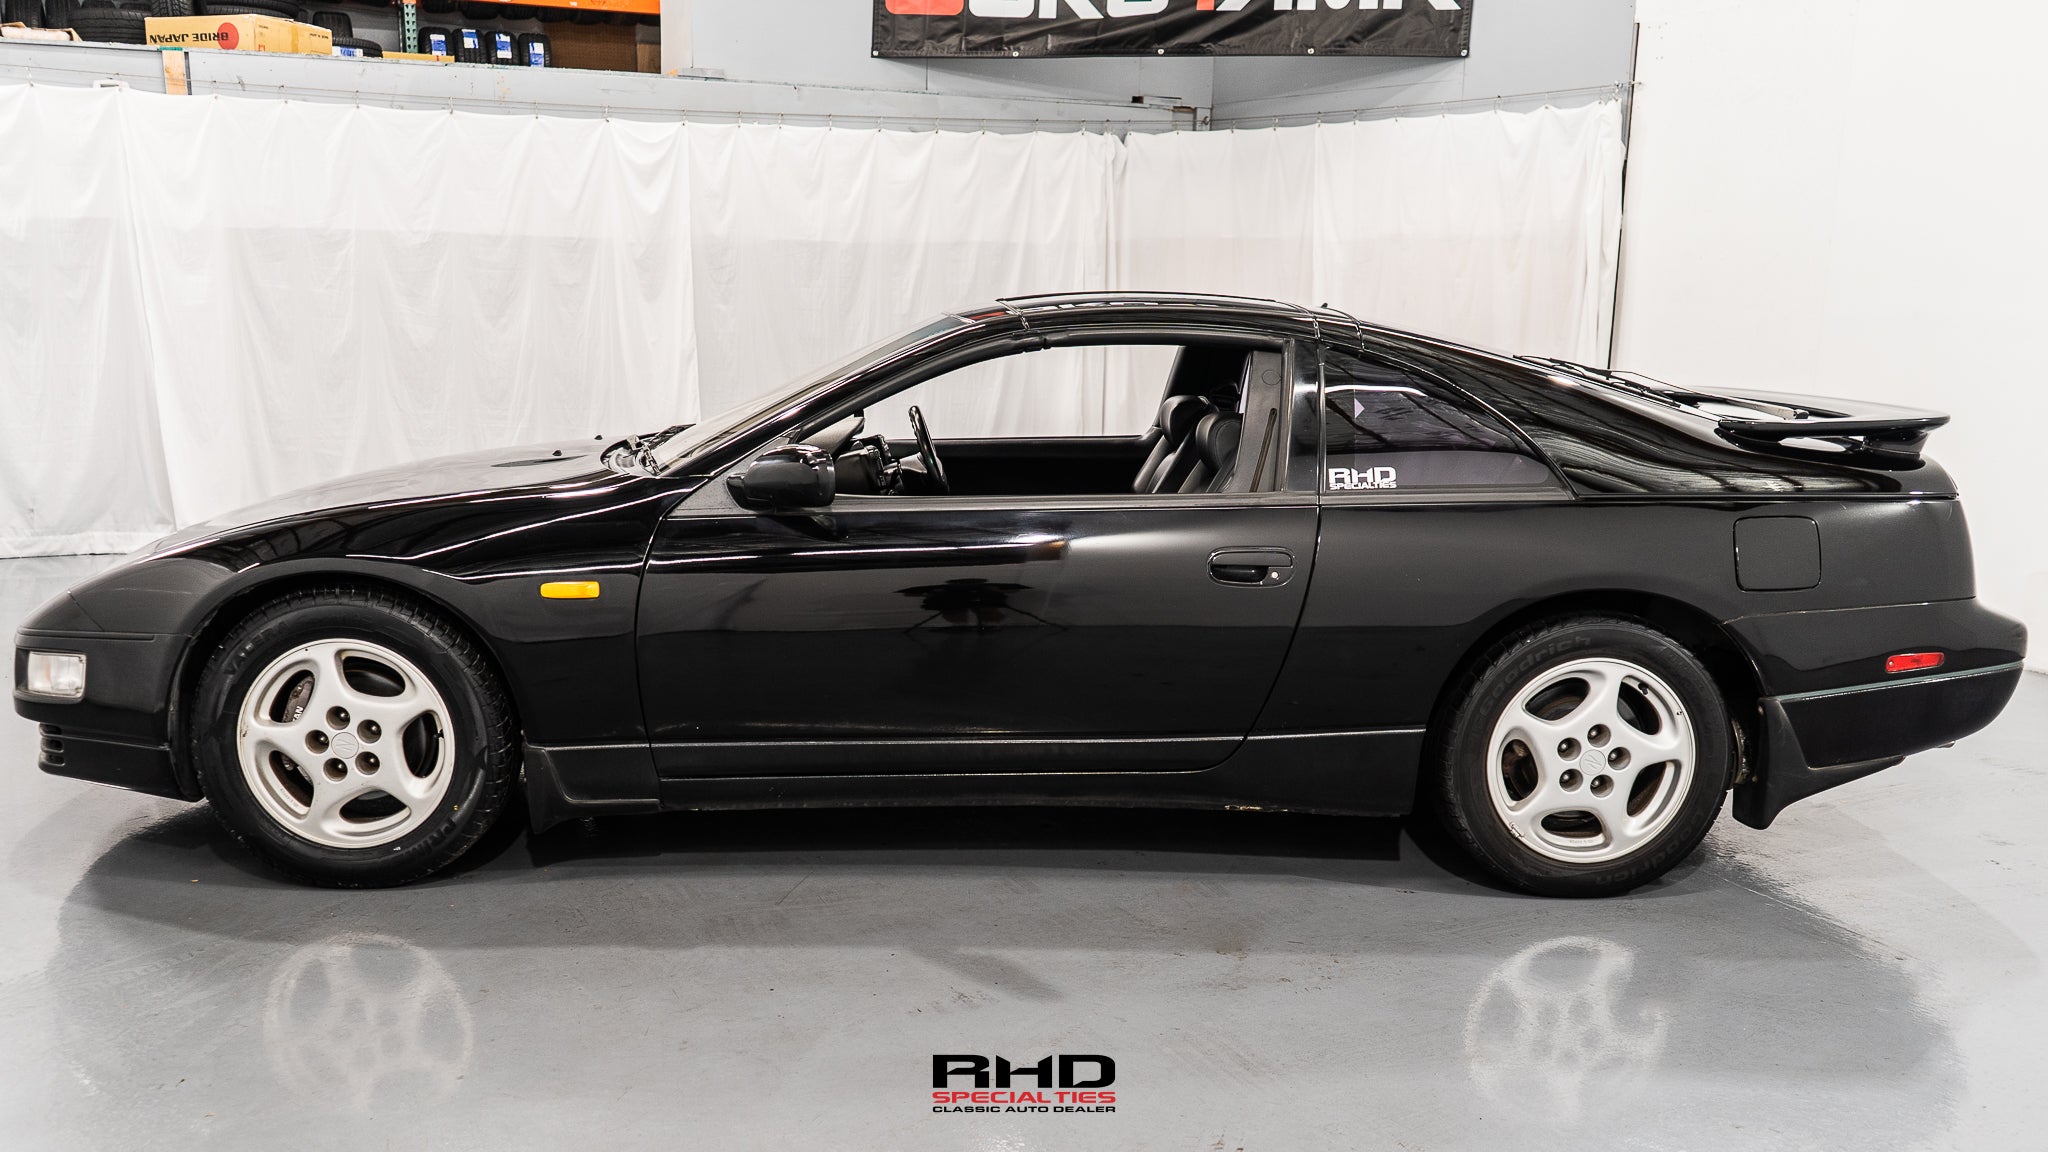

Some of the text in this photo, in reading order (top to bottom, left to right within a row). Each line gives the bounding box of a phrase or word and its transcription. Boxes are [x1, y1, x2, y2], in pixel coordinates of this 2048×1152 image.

[149, 31, 229, 44] BRIDE JAPAN
[1328, 466, 1397, 485] RHD
[1330, 480, 1397, 490] SPECIALTIES
